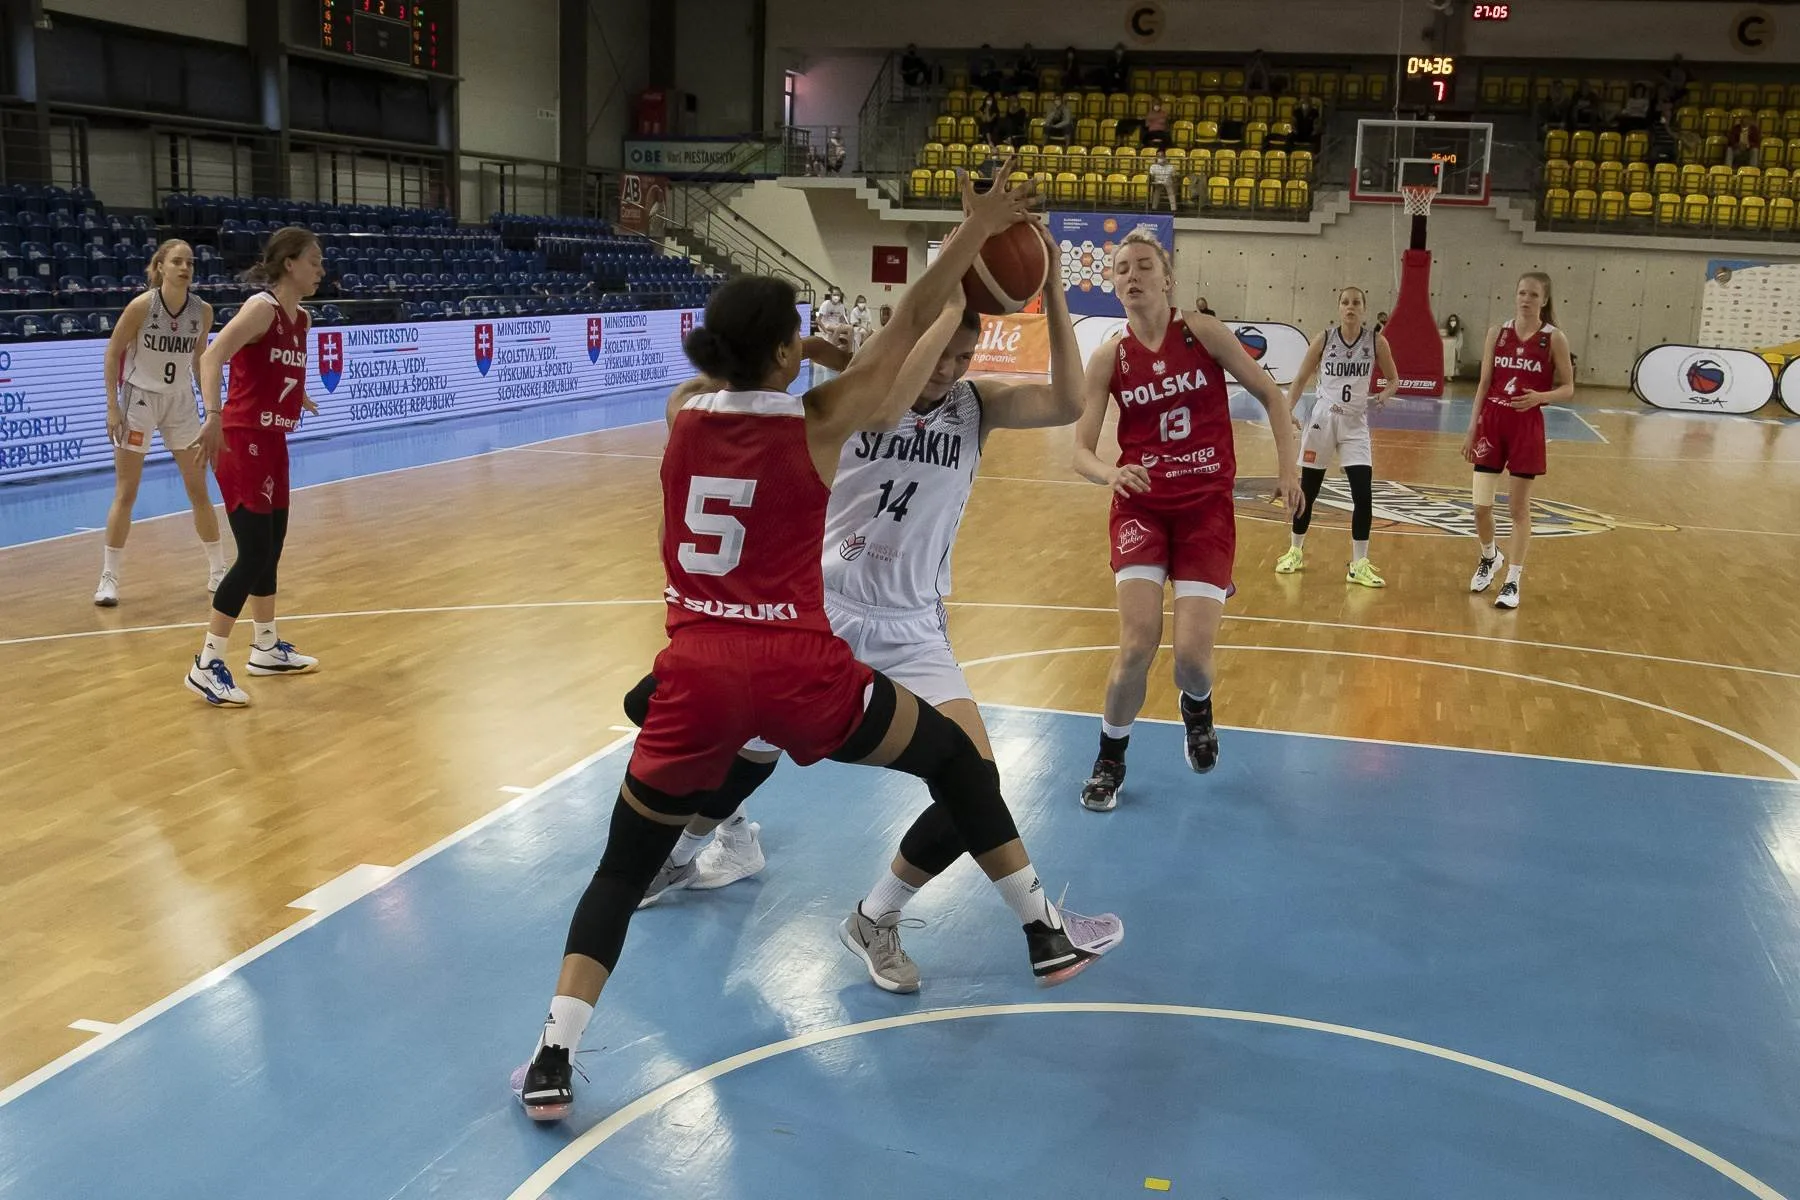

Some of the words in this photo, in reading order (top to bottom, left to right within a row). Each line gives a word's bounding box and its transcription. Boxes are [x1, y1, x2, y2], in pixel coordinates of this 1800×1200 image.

[1433, 81, 1444, 101] 7
[622, 175, 641, 203] AB
[497, 320, 551, 336] MINISTERSTVO
[604, 315, 648, 329] MINISTERSTVO
[348, 327, 419, 346] MINISTERSTVO
[975, 320, 1021, 351] iké
[270, 347, 307, 368] POLSK
[538, 346, 558, 361] VEDY,
[1494, 356, 1542, 373] POLSKA
[164, 361, 176, 385] 9
[349, 359, 401, 379] ŠKOLSTVA,
[403, 357, 429, 374] VEDY,
[497, 365, 536, 382] VÝSKUMU
[537, 365, 543, 377] A
[544, 360, 573, 376] ŠPORTU
[279, 377, 298, 403] 7
[350, 379, 400, 399] VÝSKUMU
[402, 380, 409, 394] A
[411, 374, 448, 392] ŠPORTU
[543, 376, 579, 394] REPUBLIKY
[1121, 369, 1208, 408] POLSKA
[1341, 384, 1352, 403] 6
[1503, 376, 1518, 396] 4
[350, 401, 408, 421] SLOVENSKEJ
[410, 393, 456, 412] REPUBLIKY
[0, 416, 67, 441] ŠPORTU
[275, 414, 299, 431] Ener
[1159, 405, 1192, 443] 13
[0, 439, 84, 470] REPUBLIKY
[873, 479, 920, 523] 14
[677, 475, 758, 577] 5
[683, 597, 799, 622] SUZUKI
